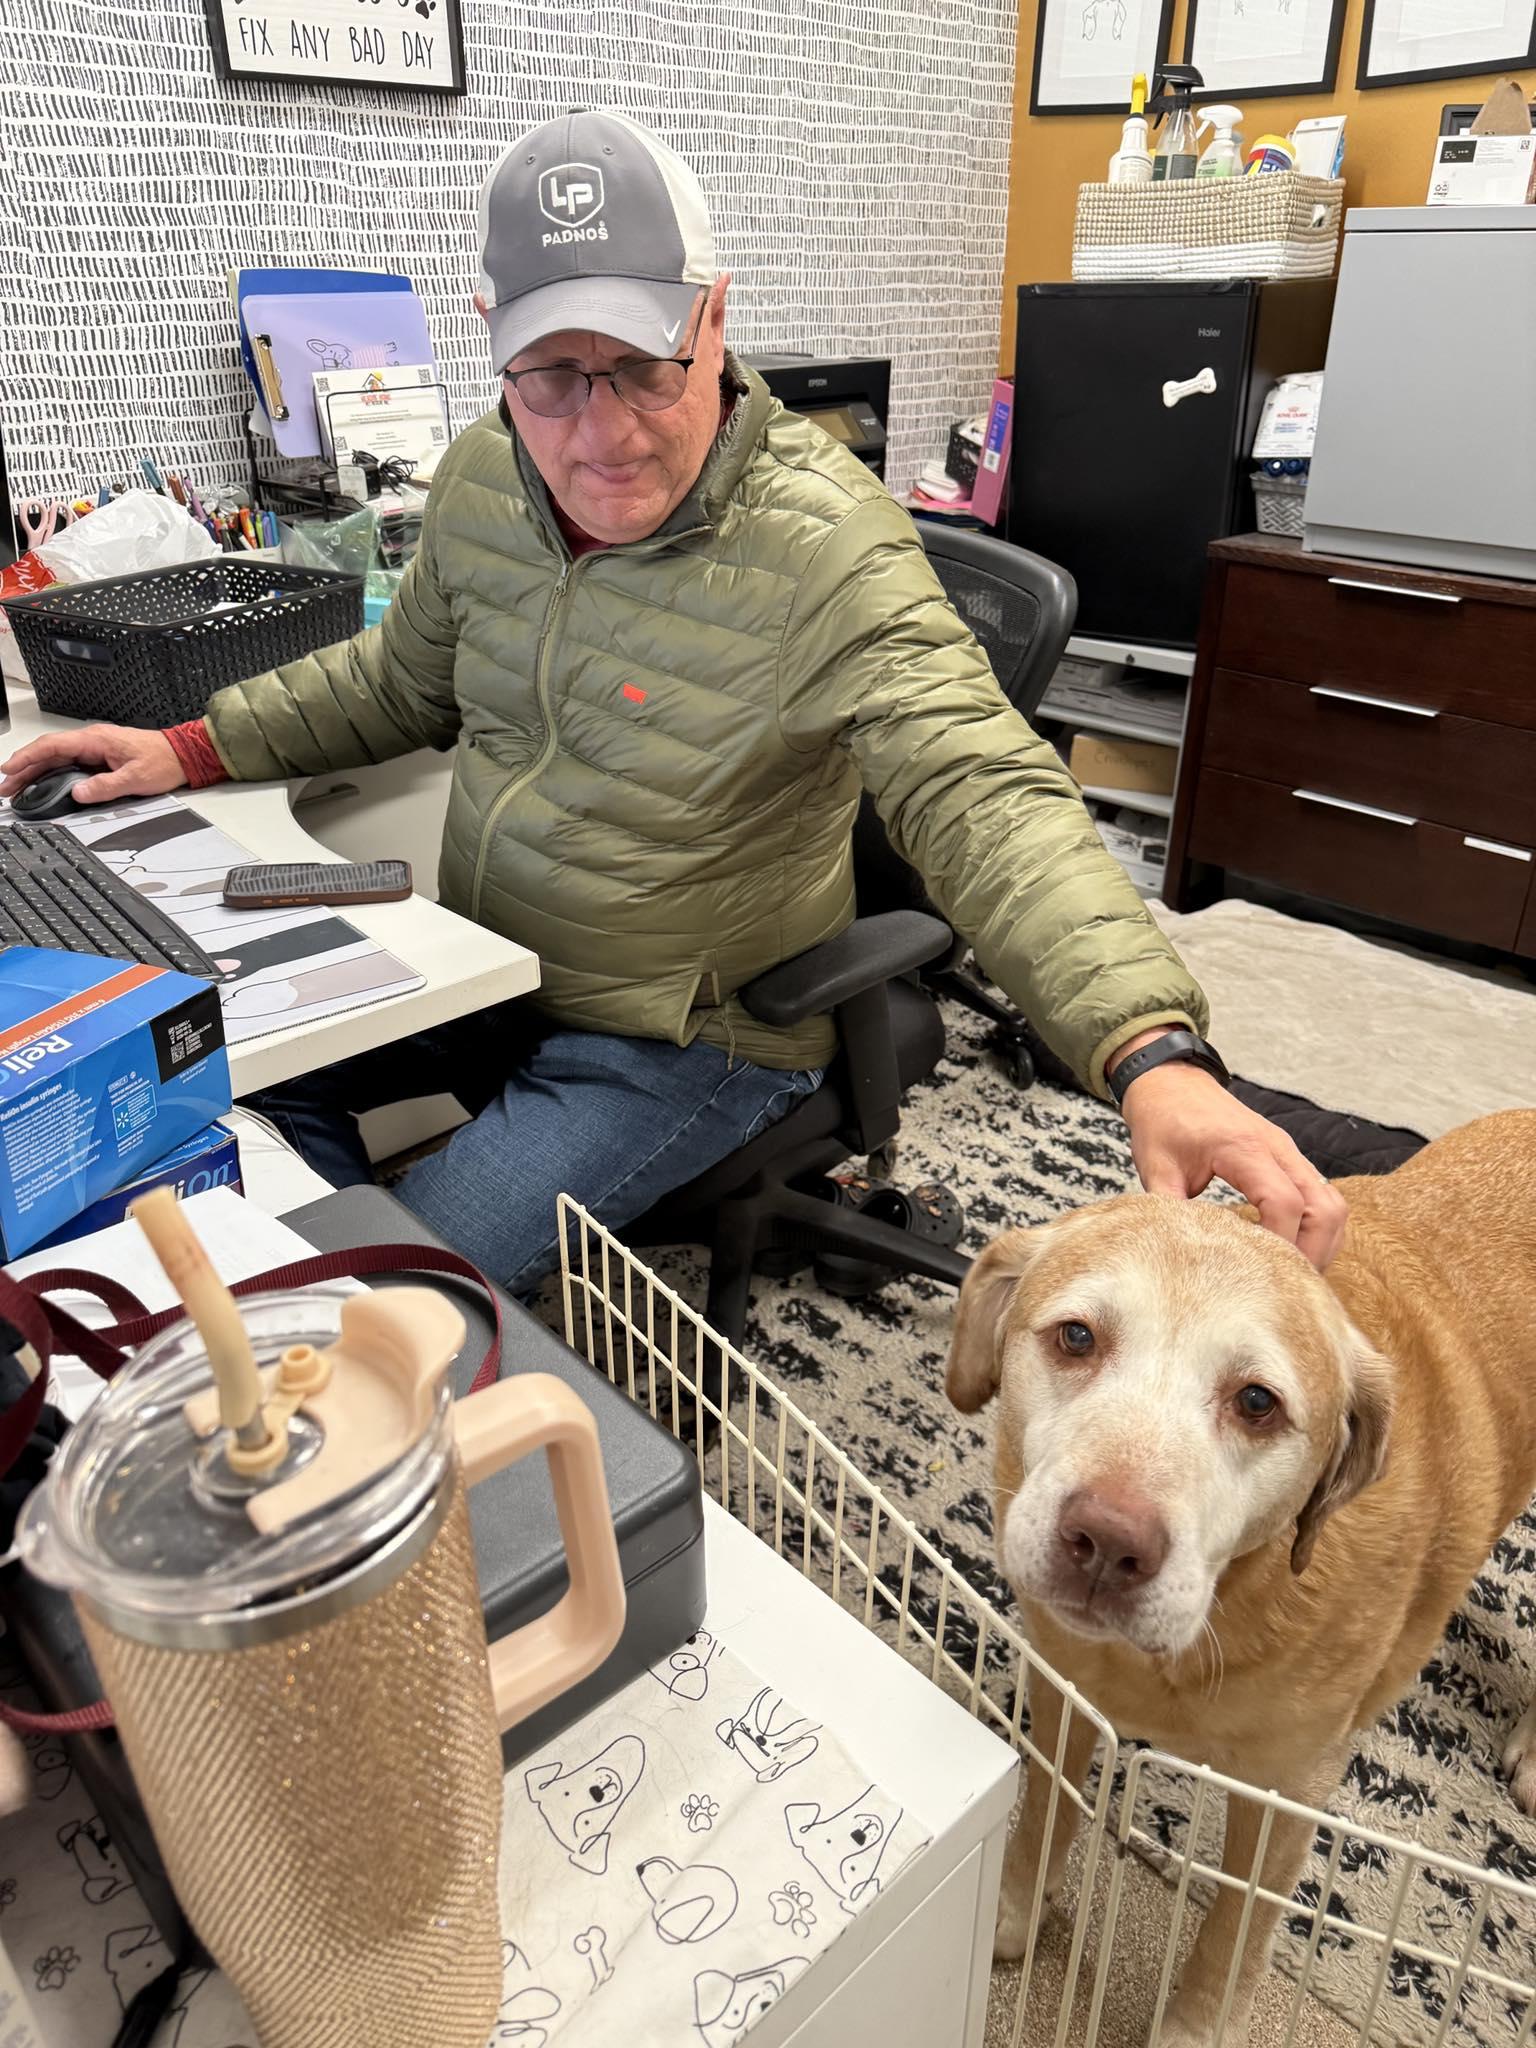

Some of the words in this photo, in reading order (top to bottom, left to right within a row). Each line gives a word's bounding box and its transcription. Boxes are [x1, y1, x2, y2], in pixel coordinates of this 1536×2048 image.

[239, 17, 274, 56] FIX
[290, 19, 330, 62] ANY
[349, 26, 385, 65] BAD
[402, 31, 434, 70] DAY
[541, 227, 609, 247] PADNOS
[1198, 327, 1221, 337] Haier
[40, 1082, 62, 1100] syringes
